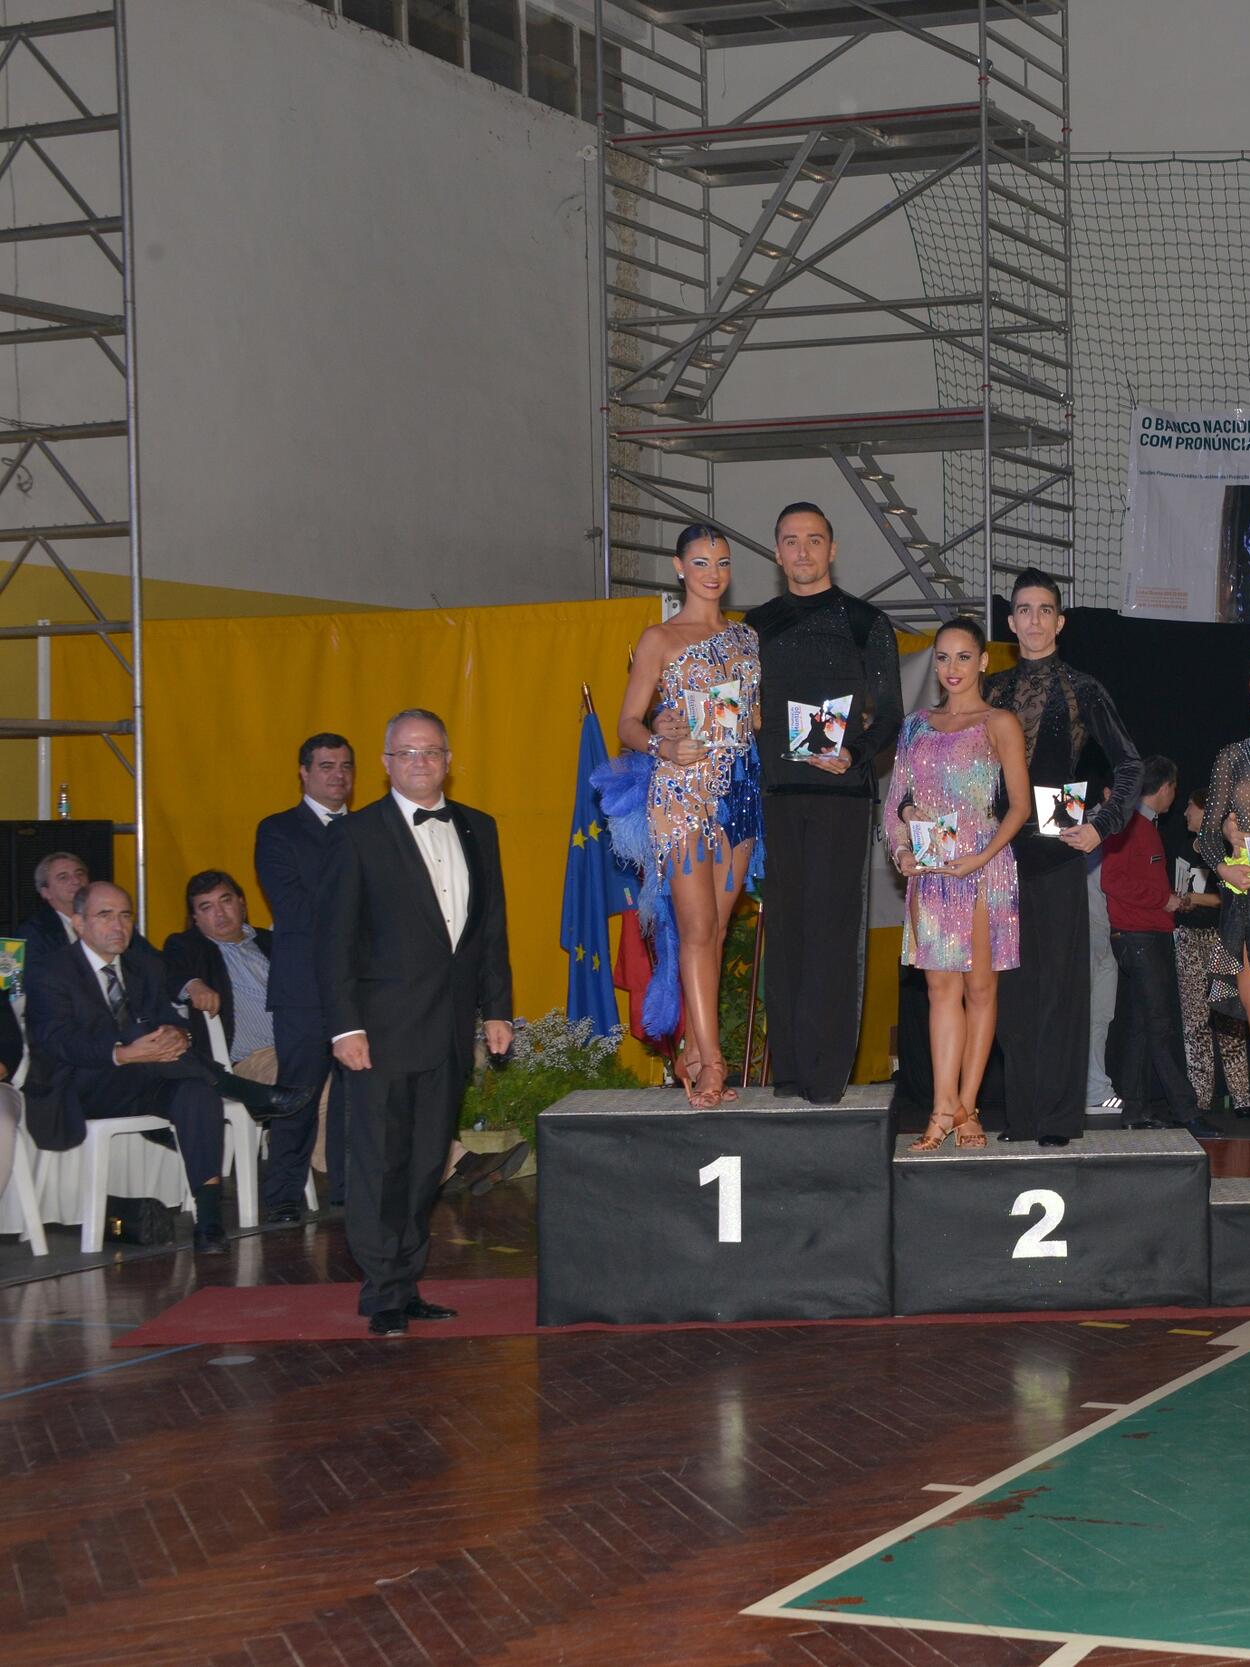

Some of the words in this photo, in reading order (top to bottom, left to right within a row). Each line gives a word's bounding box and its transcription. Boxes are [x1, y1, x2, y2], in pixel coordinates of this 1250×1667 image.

[1140, 433, 1172, 448] COM
[1141, 416, 1152, 429] O
[1155, 418, 1200, 433] BANCO
[699, 1156, 741, 1242] 1
[1009, 1188, 1068, 1258] 2
